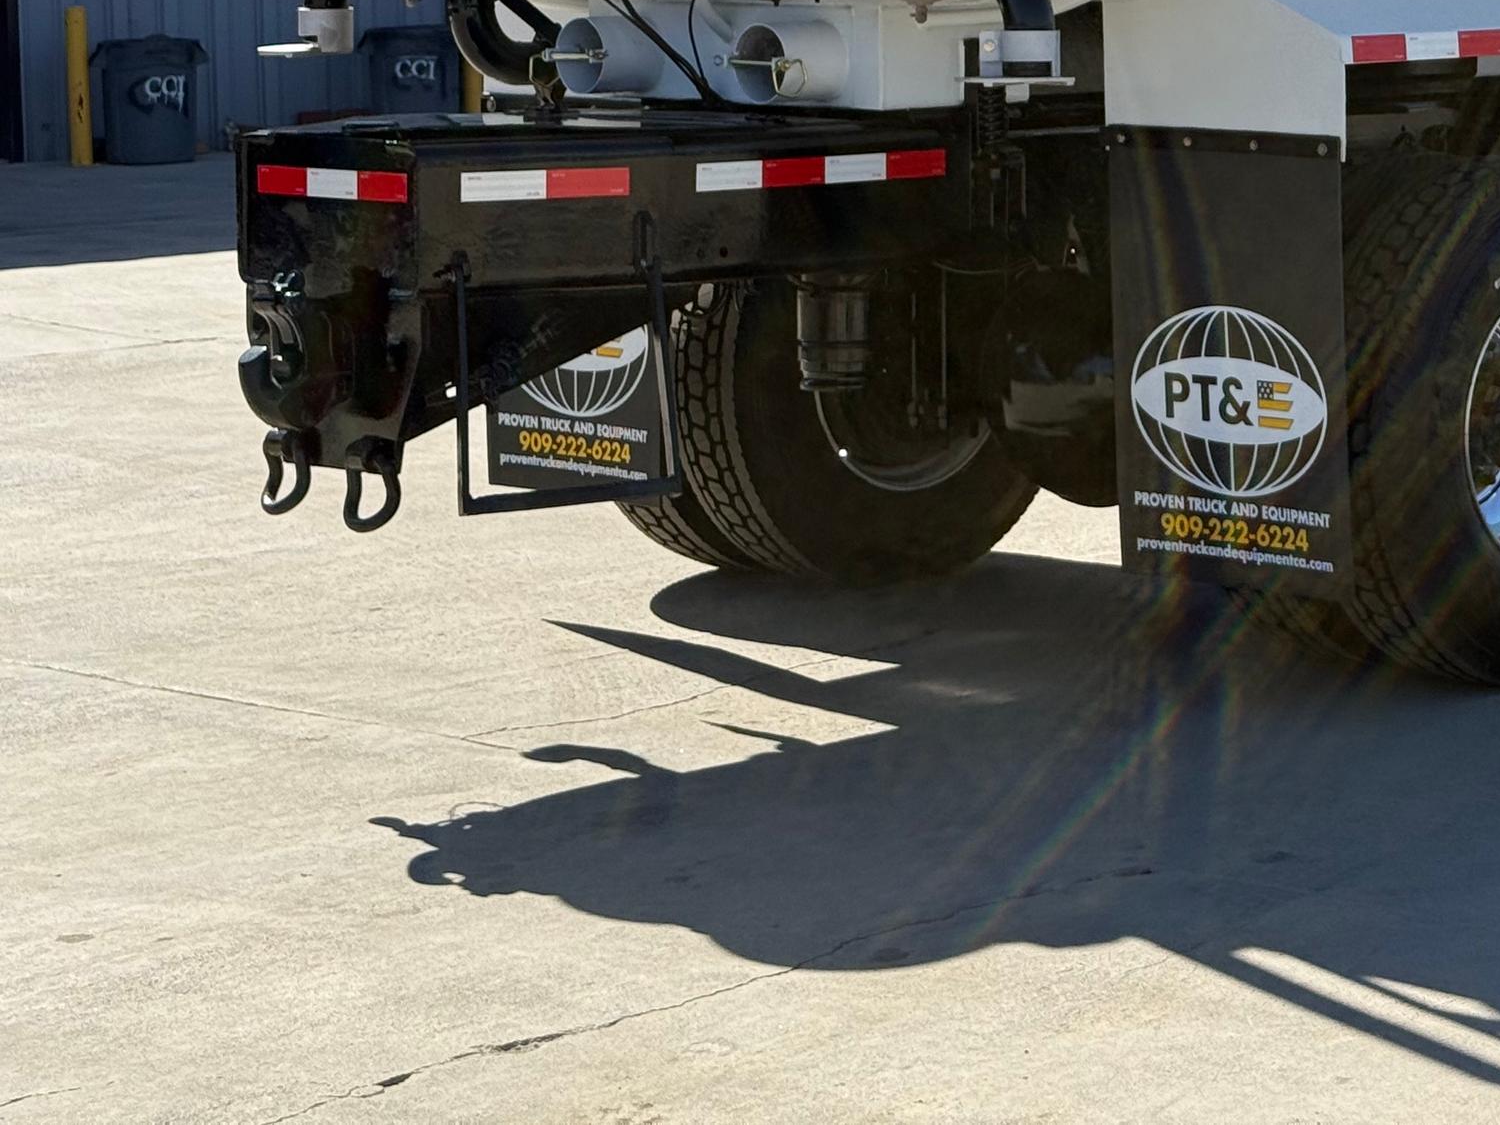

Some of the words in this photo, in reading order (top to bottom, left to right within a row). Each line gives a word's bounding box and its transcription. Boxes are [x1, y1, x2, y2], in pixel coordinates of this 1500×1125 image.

[395, 58, 435, 80] CCI
[498, 411, 539, 429] PROVEN
[540, 416, 572, 433] TRUCK
[573, 420, 595, 435] AND
[597, 423, 648, 443] EQUIPMENT
[519, 430, 631, 464] 909-222-6224
[1134, 490, 1185, 510] PROVEN
[1187, 495, 1227, 515] TRUCK
[1230, 501, 1259, 518] AND
[1262, 505, 1330, 528] EQUIPMENT
[1160, 512, 1309, 552] 909-222-6224
[1137, 536, 1334, 573] proventruckandequipmentca.com
